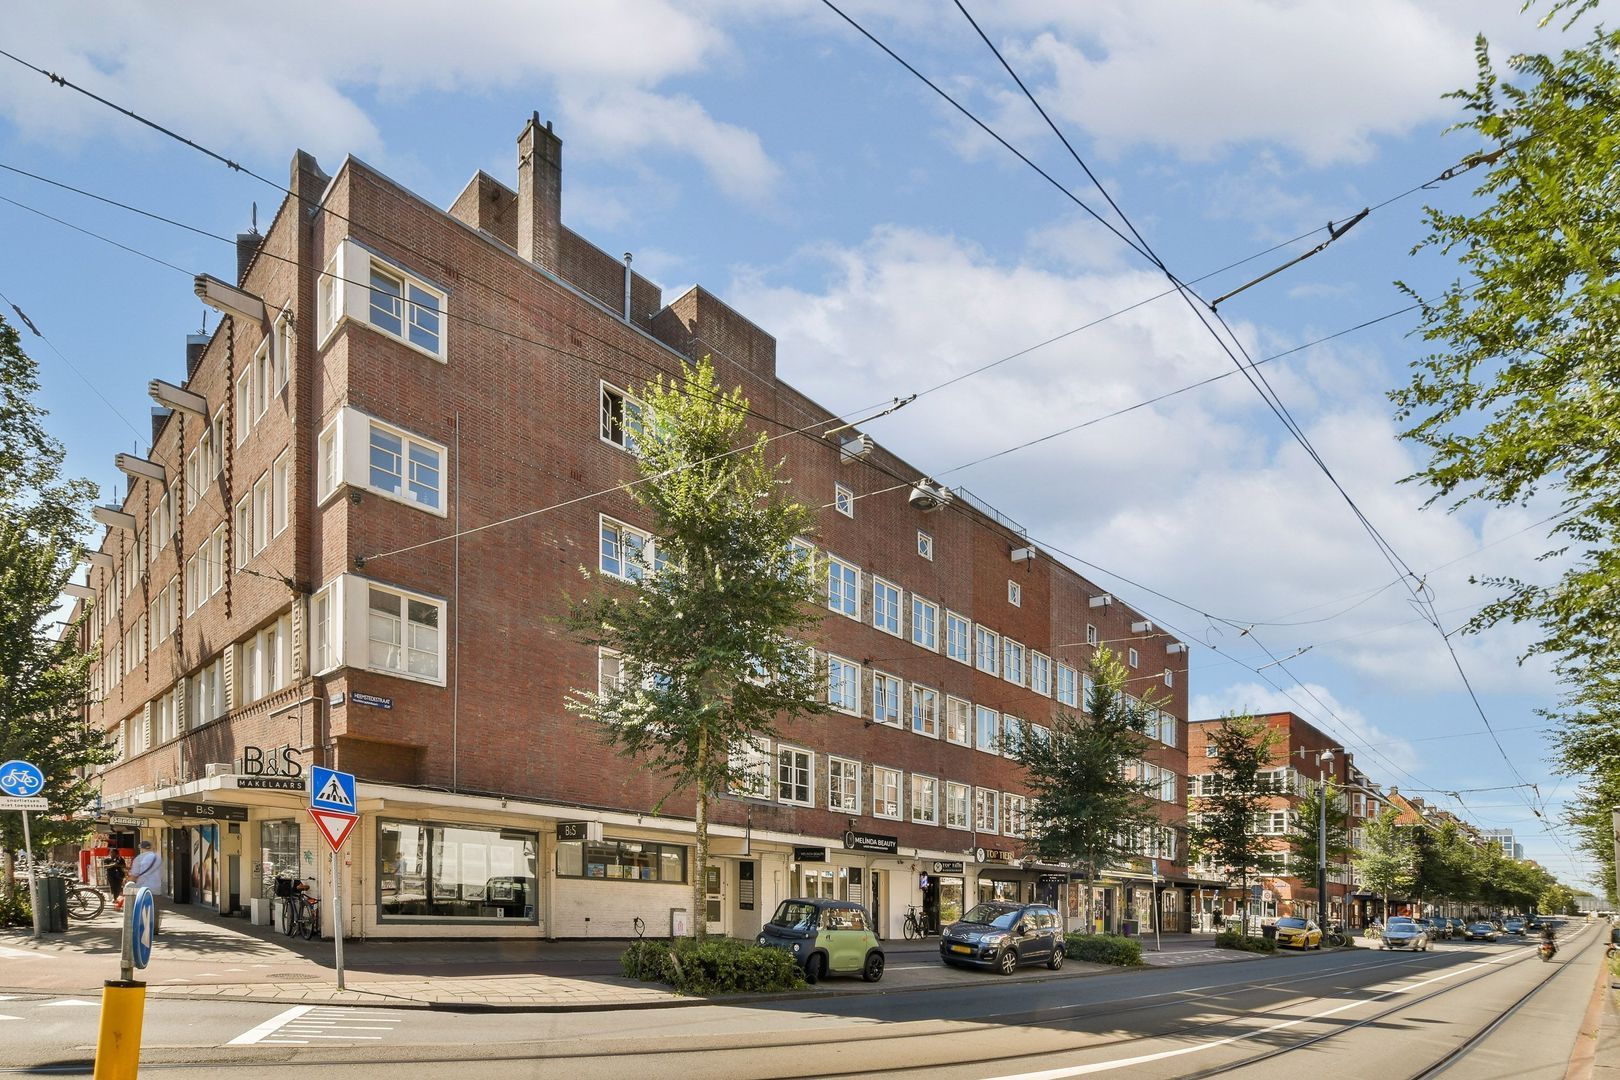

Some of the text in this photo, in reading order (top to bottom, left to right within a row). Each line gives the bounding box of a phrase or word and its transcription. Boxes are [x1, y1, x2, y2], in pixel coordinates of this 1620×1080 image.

[244, 745, 302, 778] B&S
[239, 780, 302, 790] MAKELAARS
[196, 805, 215, 816] B&S
[565, 825, 577, 836] B&S
[877, 839, 897, 848] BEAUTY
[986, 849, 999, 859] TOP
